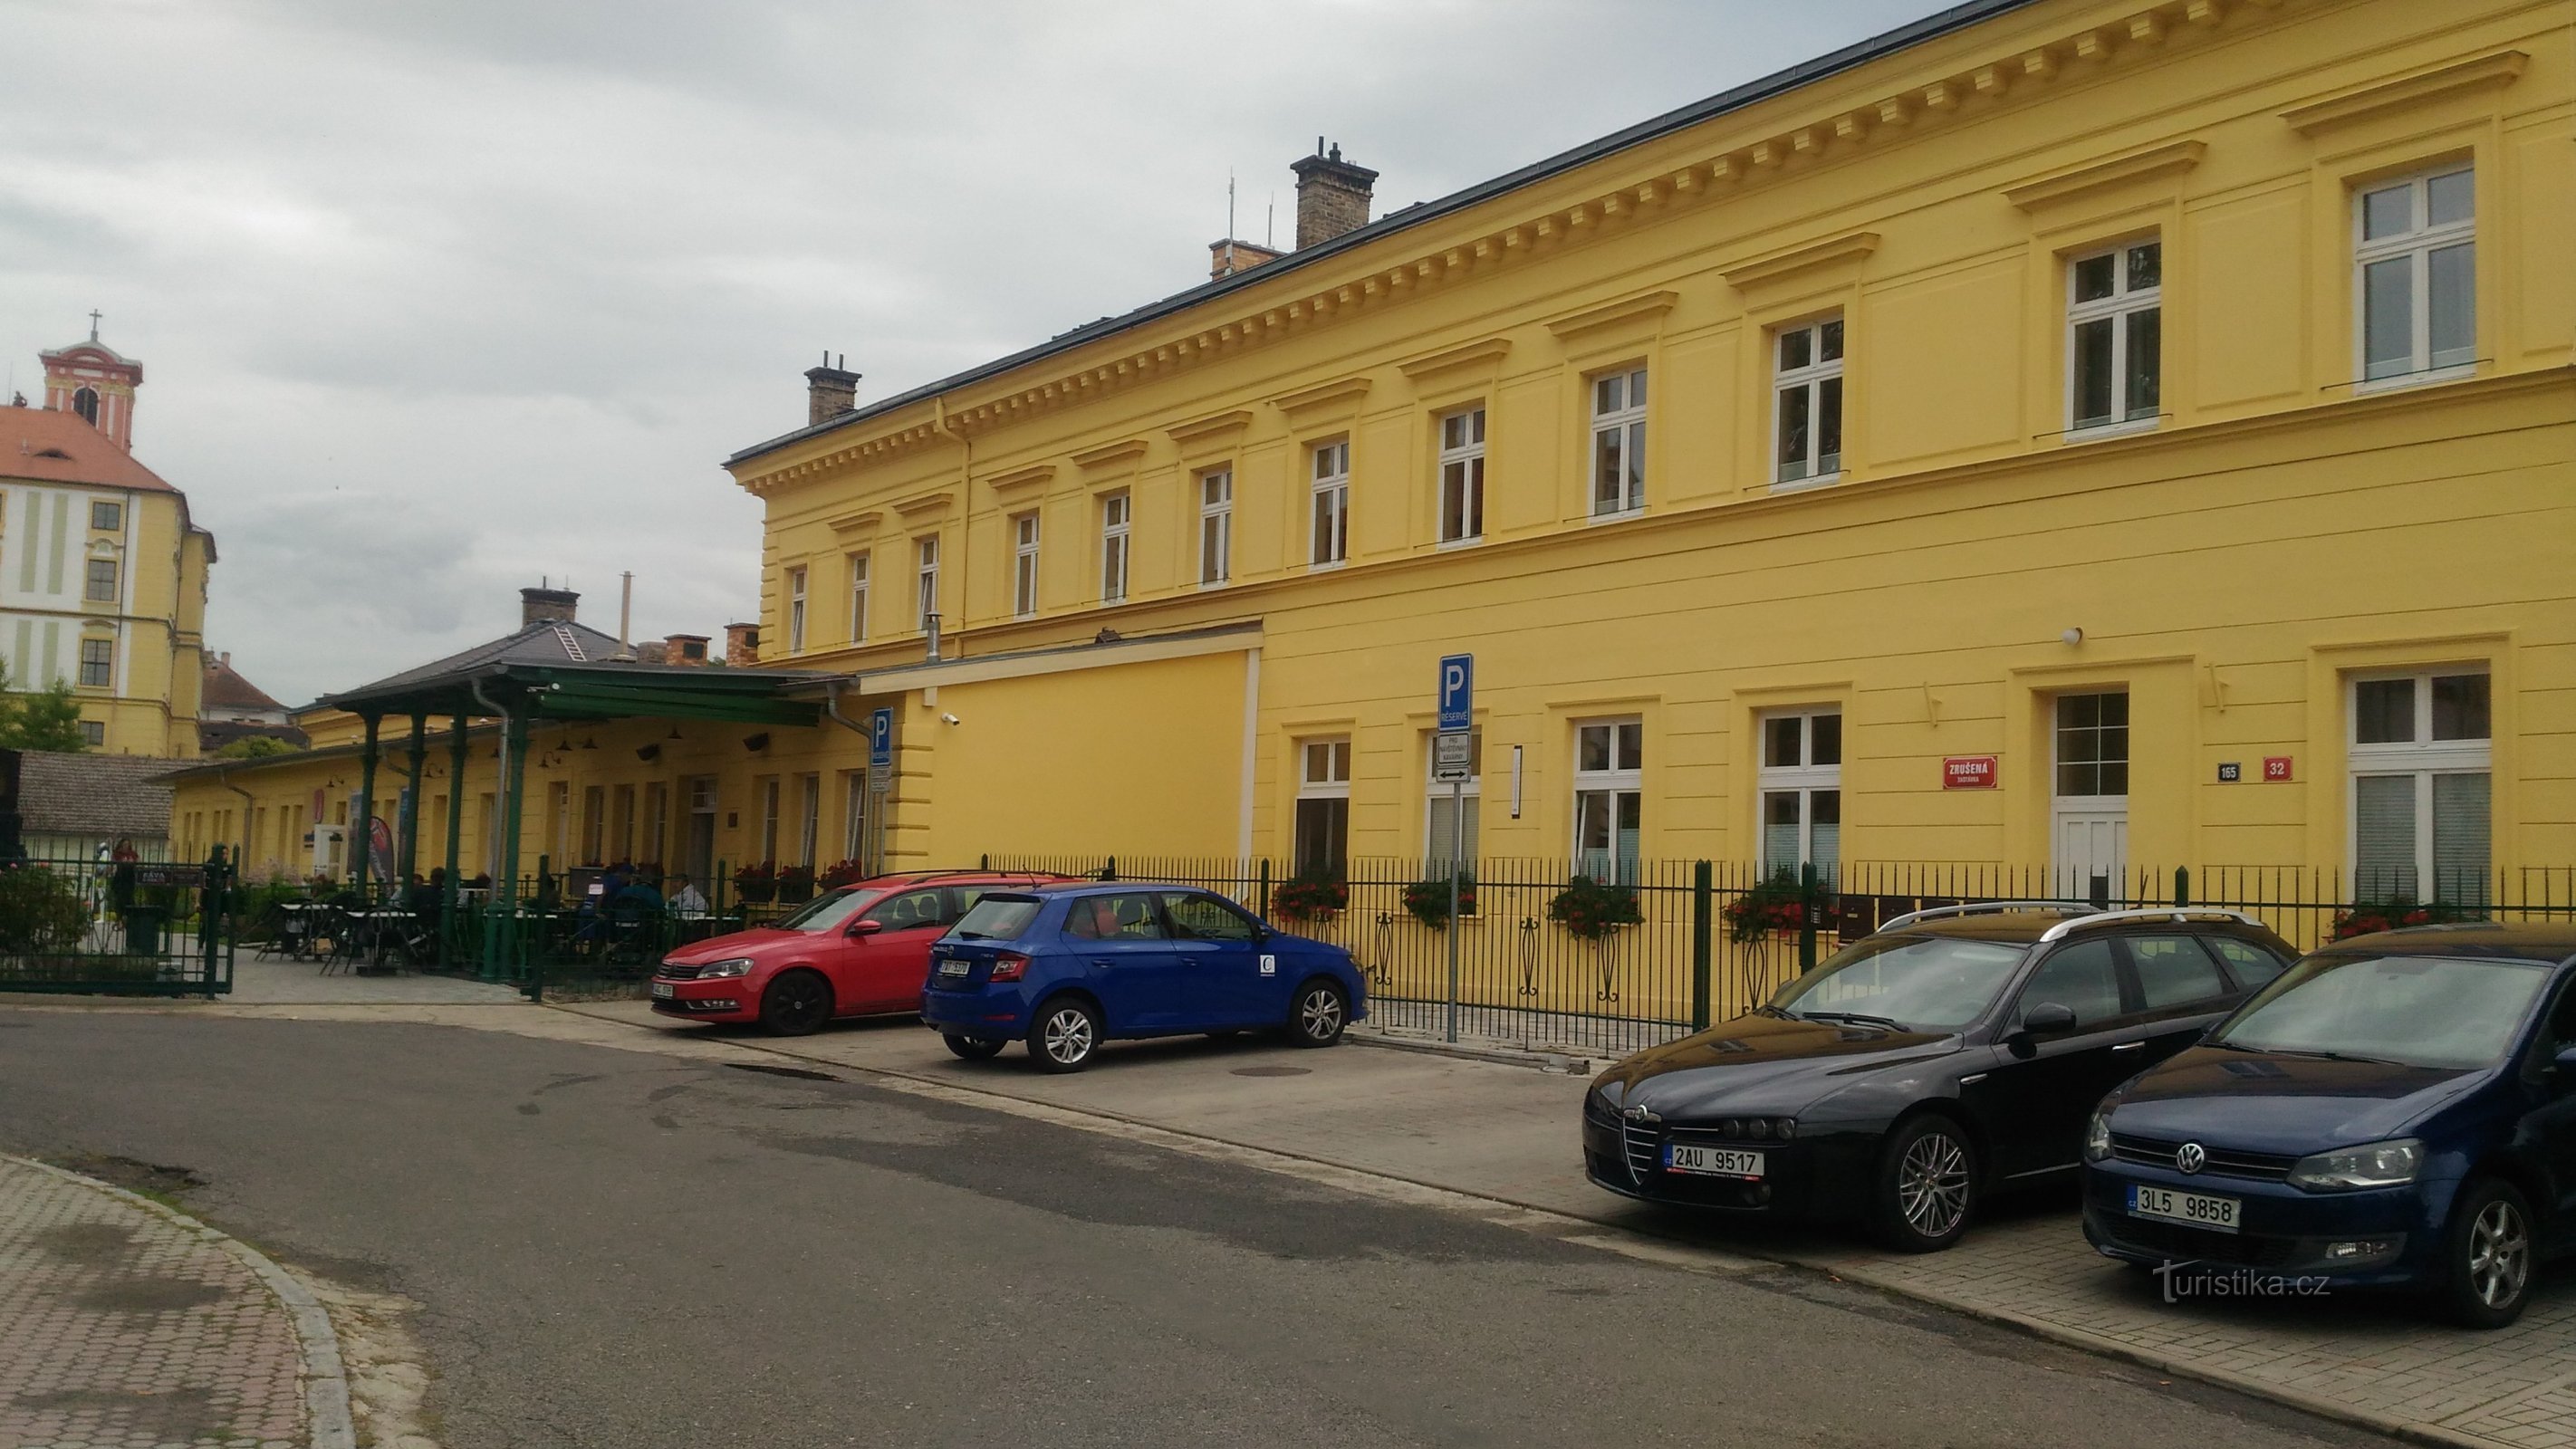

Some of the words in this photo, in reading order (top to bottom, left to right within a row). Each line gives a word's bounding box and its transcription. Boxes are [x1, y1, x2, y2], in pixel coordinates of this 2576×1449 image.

[1445, 665, 1465, 707] P
[875, 715, 887, 748] P
[1949, 762, 1988, 775] ZRUŠENÁ
[2221, 766, 2237, 779] 165
[2270, 763, 2284, 775] 32
[1676, 1147, 1703, 1167] 2AU
[1716, 1152, 1756, 1173] 9517
[2141, 1190, 2172, 1213] 3L5
[2186, 1196, 2232, 1223] 9858
